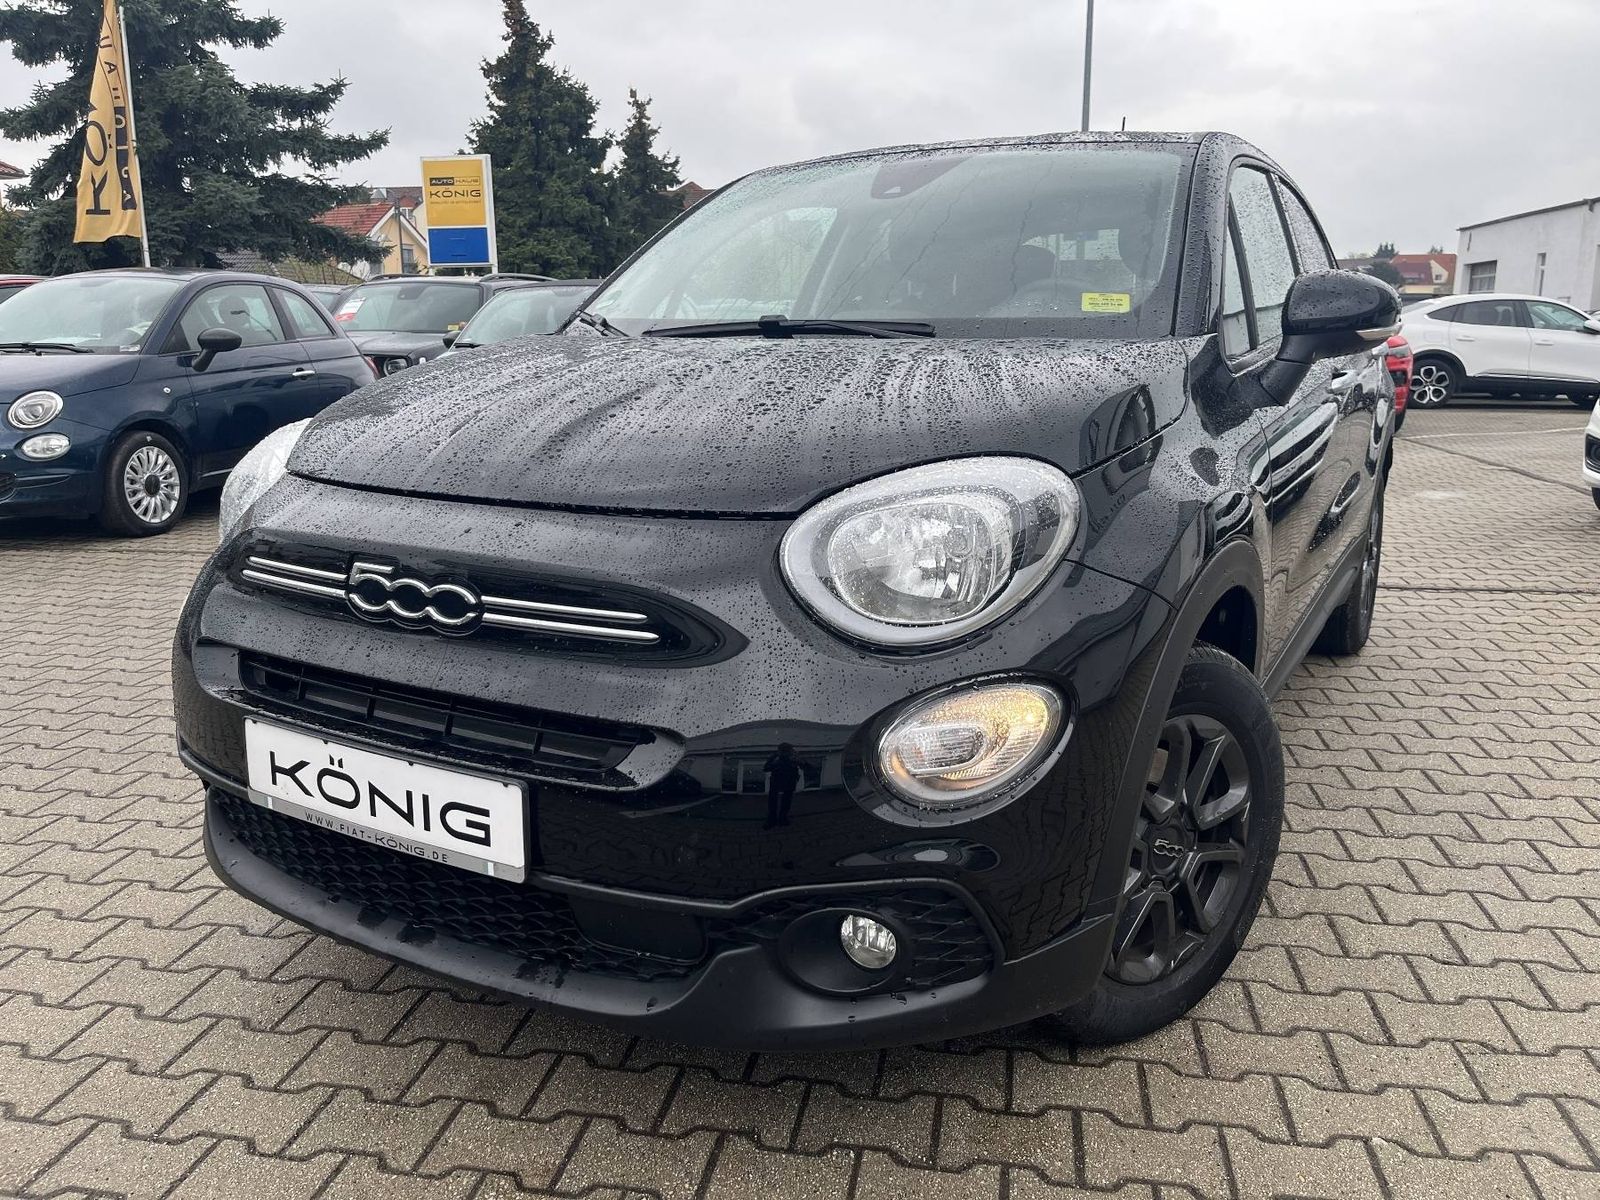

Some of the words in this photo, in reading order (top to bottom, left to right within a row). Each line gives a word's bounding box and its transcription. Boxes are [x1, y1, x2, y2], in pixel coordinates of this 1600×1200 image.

[429, 187, 481, 199] KÖNIG
[349, 562, 478, 626] 500
[269, 750, 491, 847] KÖNIG
[305, 812, 448, 863] WWW.FIAT-KÖNIG.DE
[1154, 839, 1184, 858] 500
